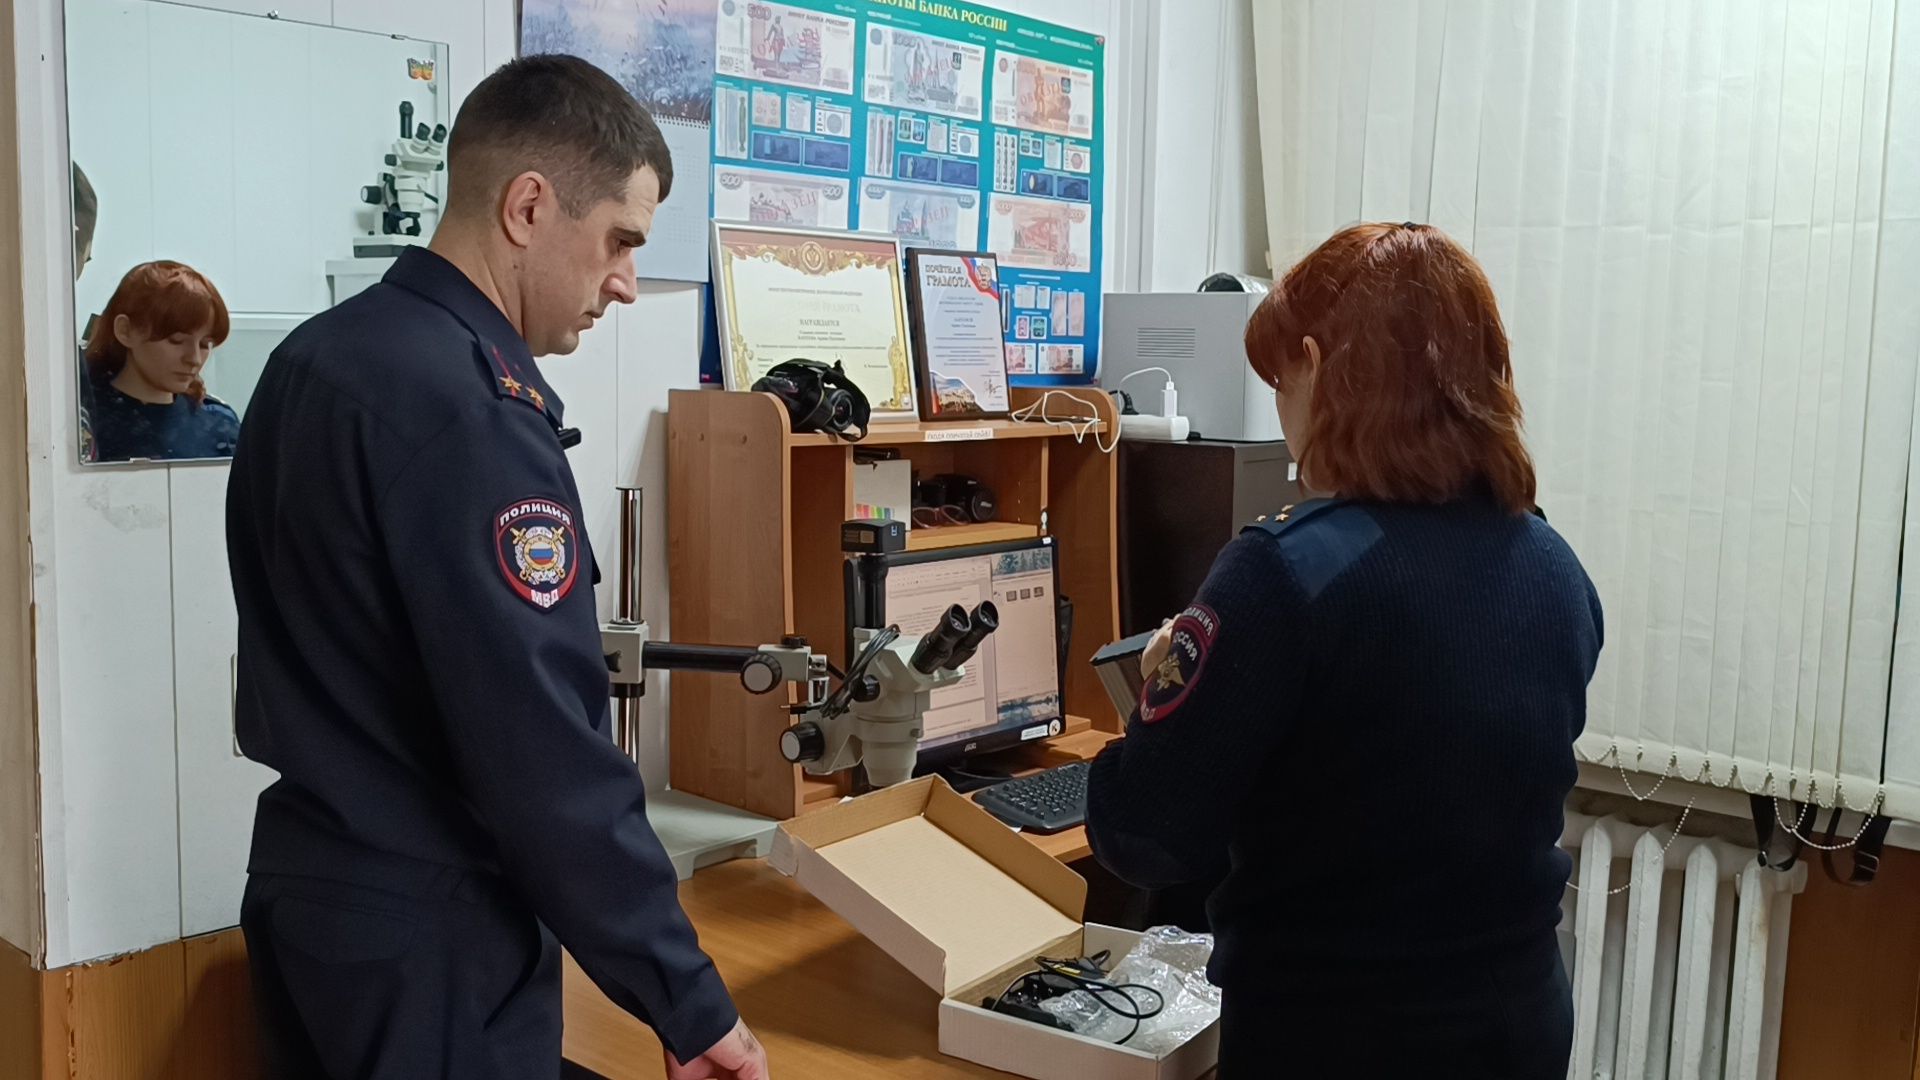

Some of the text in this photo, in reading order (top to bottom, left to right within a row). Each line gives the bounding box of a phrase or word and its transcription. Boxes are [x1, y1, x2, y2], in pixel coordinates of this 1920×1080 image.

[747, 3, 772, 20] 500
[870, 0, 916, 10] ОТЫ
[919, 1, 958, 20] БАНКА
[961, 9, 1007, 31] РОССИИ
[721, 174, 741, 187] 500
[823, 185, 841, 197] 500
[926, 275, 971, 288] ГРАМОТА
[500, 503, 571, 526] ПОЛИЦИЯ
[530, 588, 559, 608] МВД
[1182, 607, 1214, 637] ЛИЦИЯ
[1172, 631, 1198, 661] ОССИЯ
